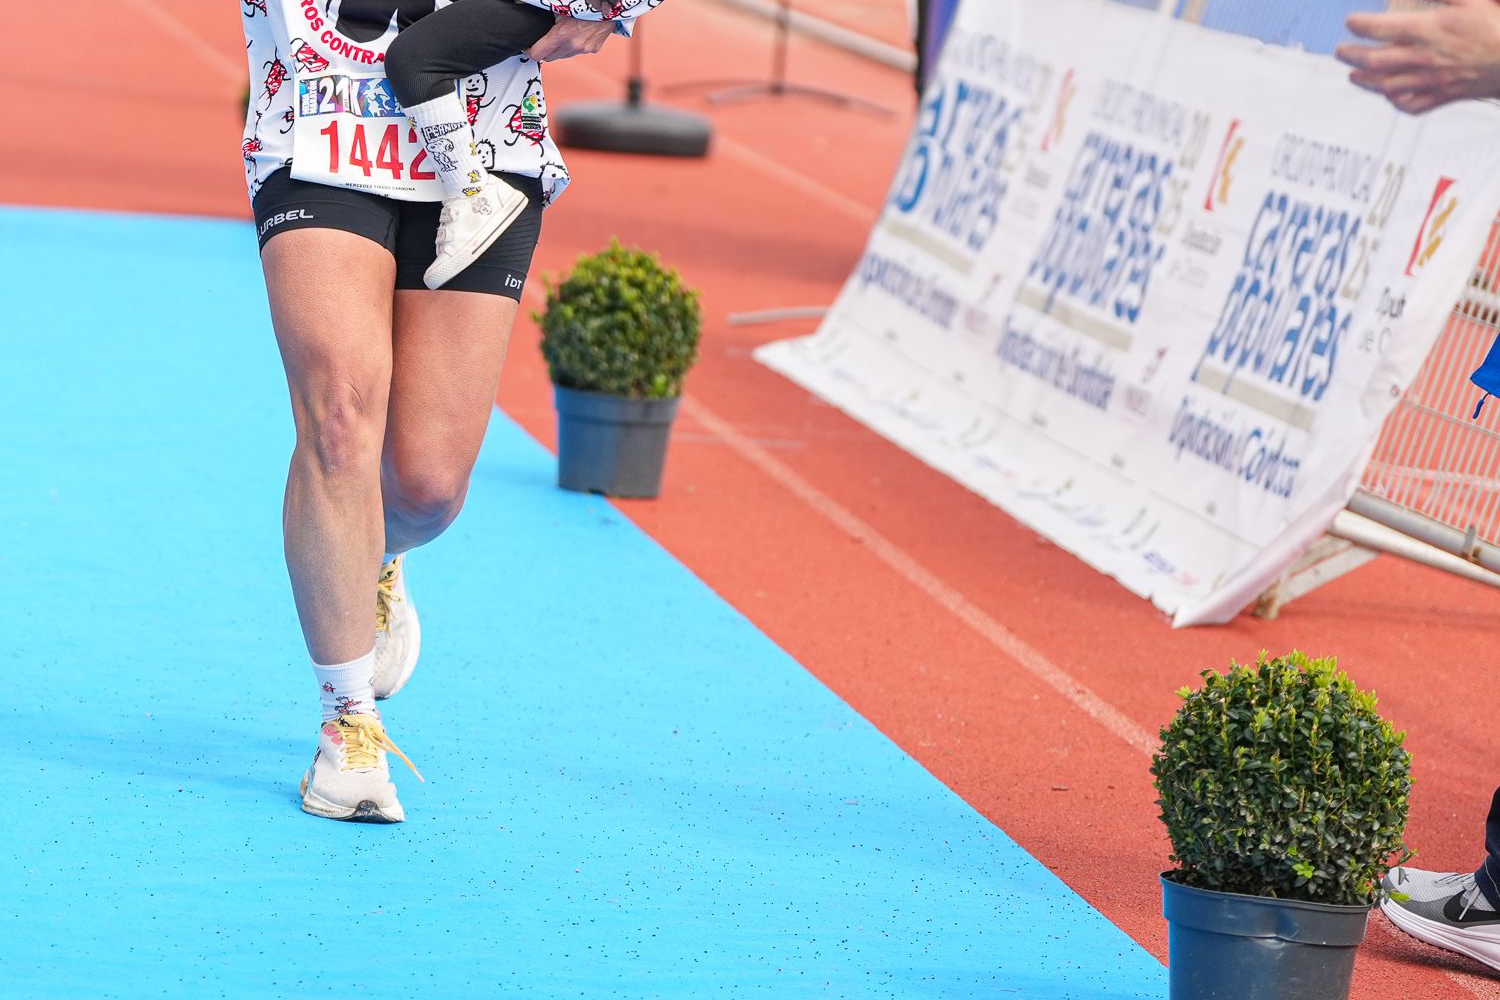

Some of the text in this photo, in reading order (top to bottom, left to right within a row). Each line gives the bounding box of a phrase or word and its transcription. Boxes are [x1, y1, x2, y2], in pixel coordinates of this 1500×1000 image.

[320, 30, 387, 65] CONTRA
[320, 120, 436, 181] 1442
[1242, 189, 1363, 304] carreras
[1190, 272, 1354, 402] populares
